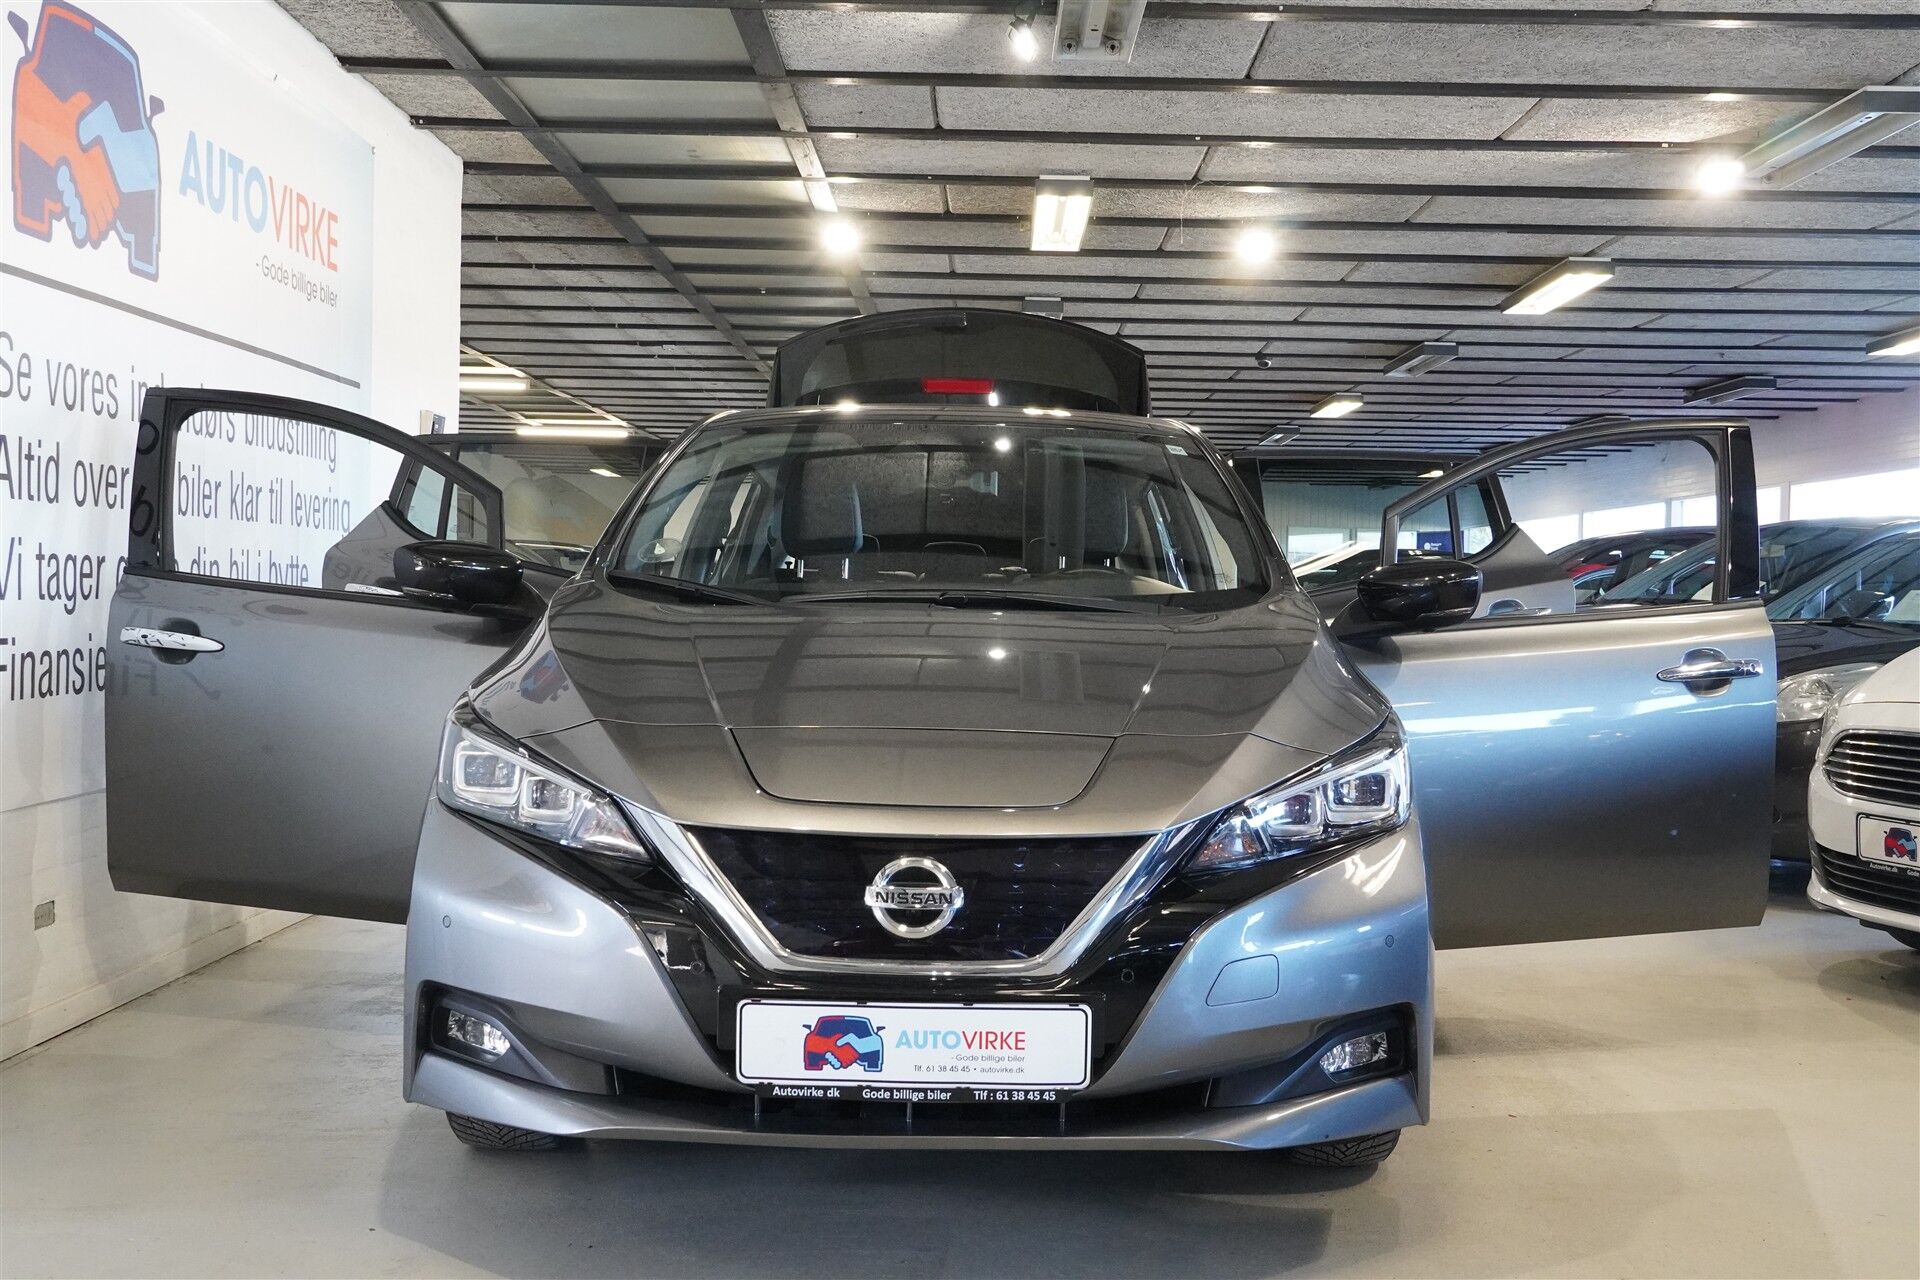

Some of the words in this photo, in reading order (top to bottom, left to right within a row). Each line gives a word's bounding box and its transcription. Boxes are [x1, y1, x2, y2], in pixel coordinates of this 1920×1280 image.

[179, 130, 338, 272] AUTOVIRKE
[261, 255, 289, 286] Gode
[291, 269, 318, 301] billige
[320, 282, 338, 308] biler
[0, 331, 32, 402] Se
[46, 358, 119, 420] vores
[0, 434, 60, 505] Altid
[73, 460, 130, 510] over
[178, 461, 222, 519] biler
[230, 470, 262, 524] klar
[269, 477, 283, 525] til
[290, 480, 350, 538] levering
[36, 542, 106, 616] tager
[875, 891, 953, 905] NISSAN
[895, 1029, 1026, 1051] AUTOVIRKE
[955, 1054, 980, 1062] Gode
[981, 1054, 1006, 1063] billige
[1007, 1055, 1025, 1063] biler
[772, 1086, 824, 1097] Autovirke
[862, 1089, 891, 1099] Gode
[893, 1089, 925, 1102] billige
[927, 1090, 952, 1100] biler
[973, 1090, 988, 1100] Tlf
[996, 1091, 1009, 1101] 61
[1011, 1091, 1025, 1101] 38
[1027, 1091, 1041, 1101] 45
[1042, 1091, 1056, 1101] 45
